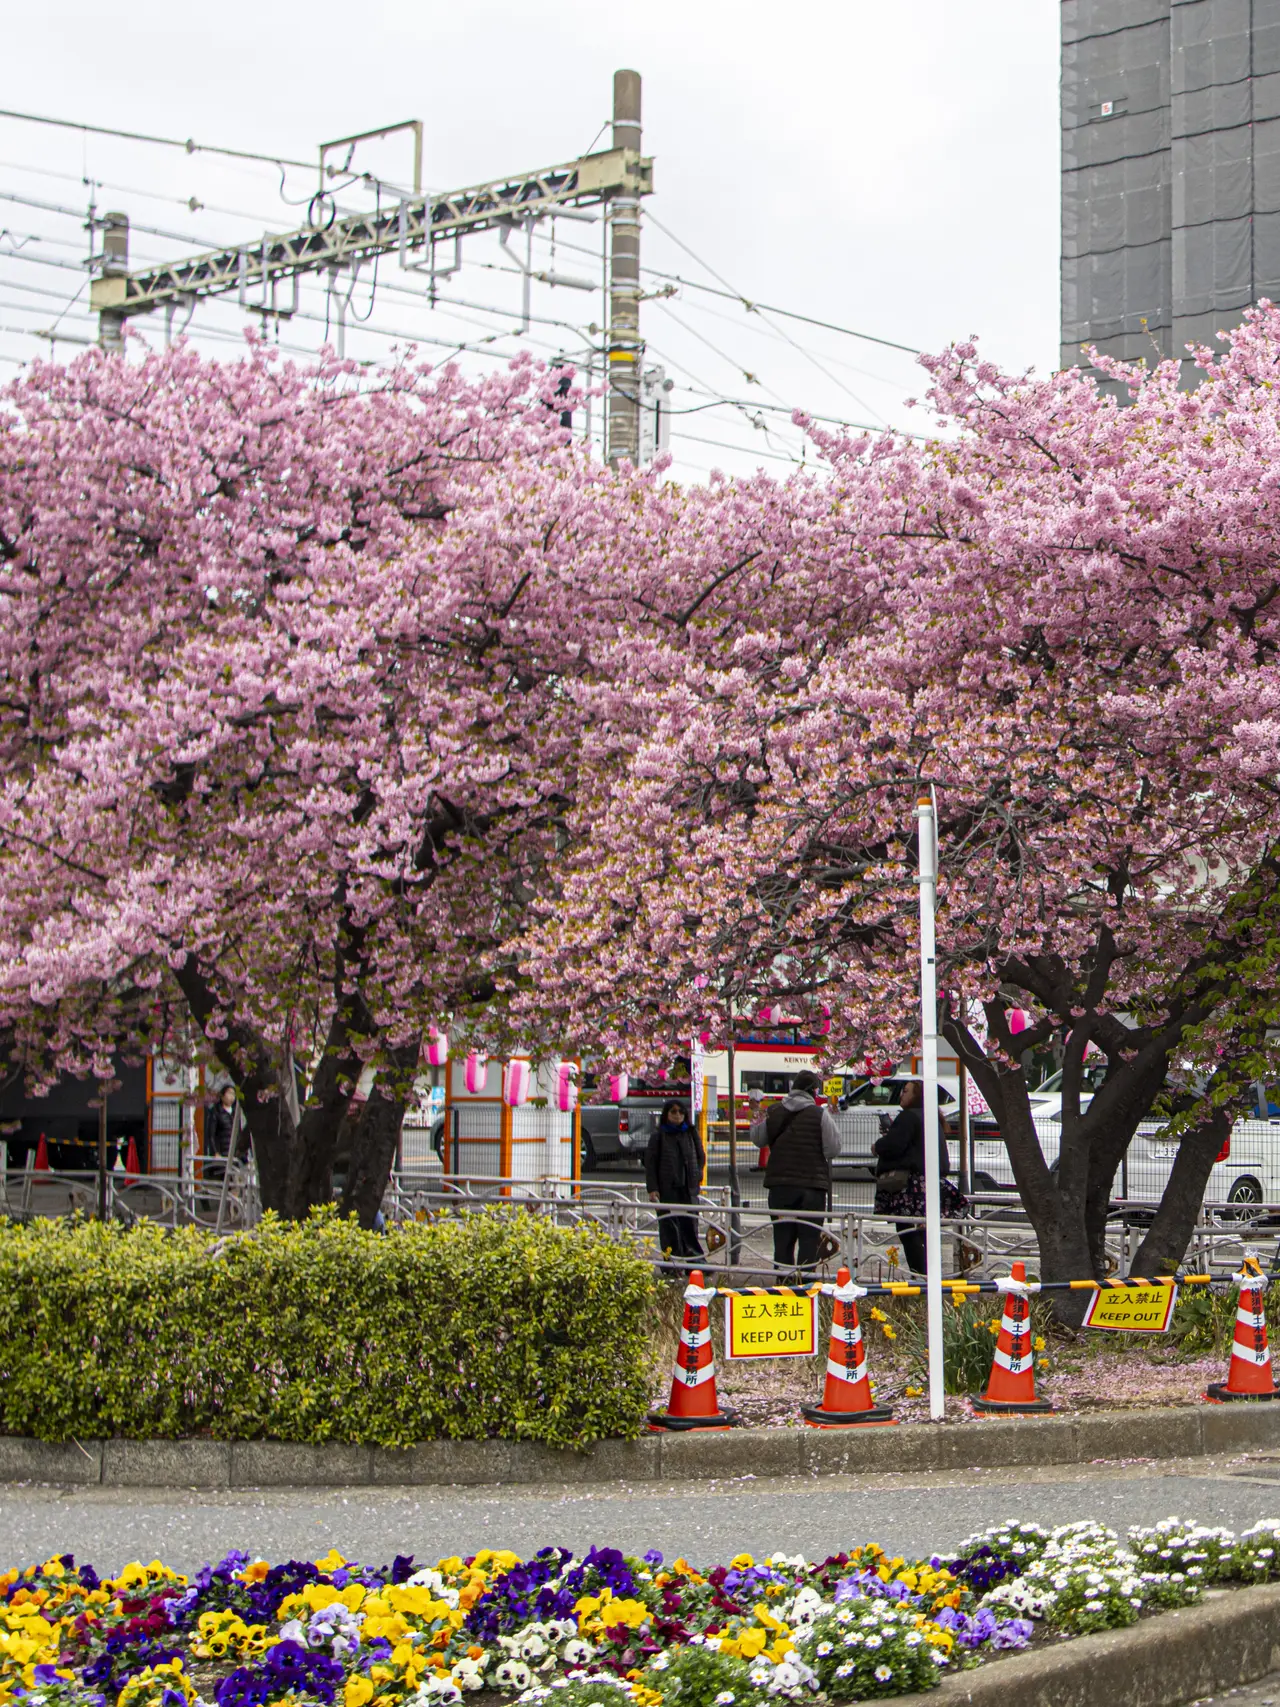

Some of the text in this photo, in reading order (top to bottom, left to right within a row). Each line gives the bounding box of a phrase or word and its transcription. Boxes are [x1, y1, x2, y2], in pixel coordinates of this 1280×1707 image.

[783, 1056, 808, 1064] KEIKYU
[1105, 1291, 1163, 1305] 立入禁止
[741, 1301, 804, 1319] 立入禁止
[1099, 1312, 1161, 1322] KEEP OUT
[741, 1329, 806, 1344] KEEP OUT
